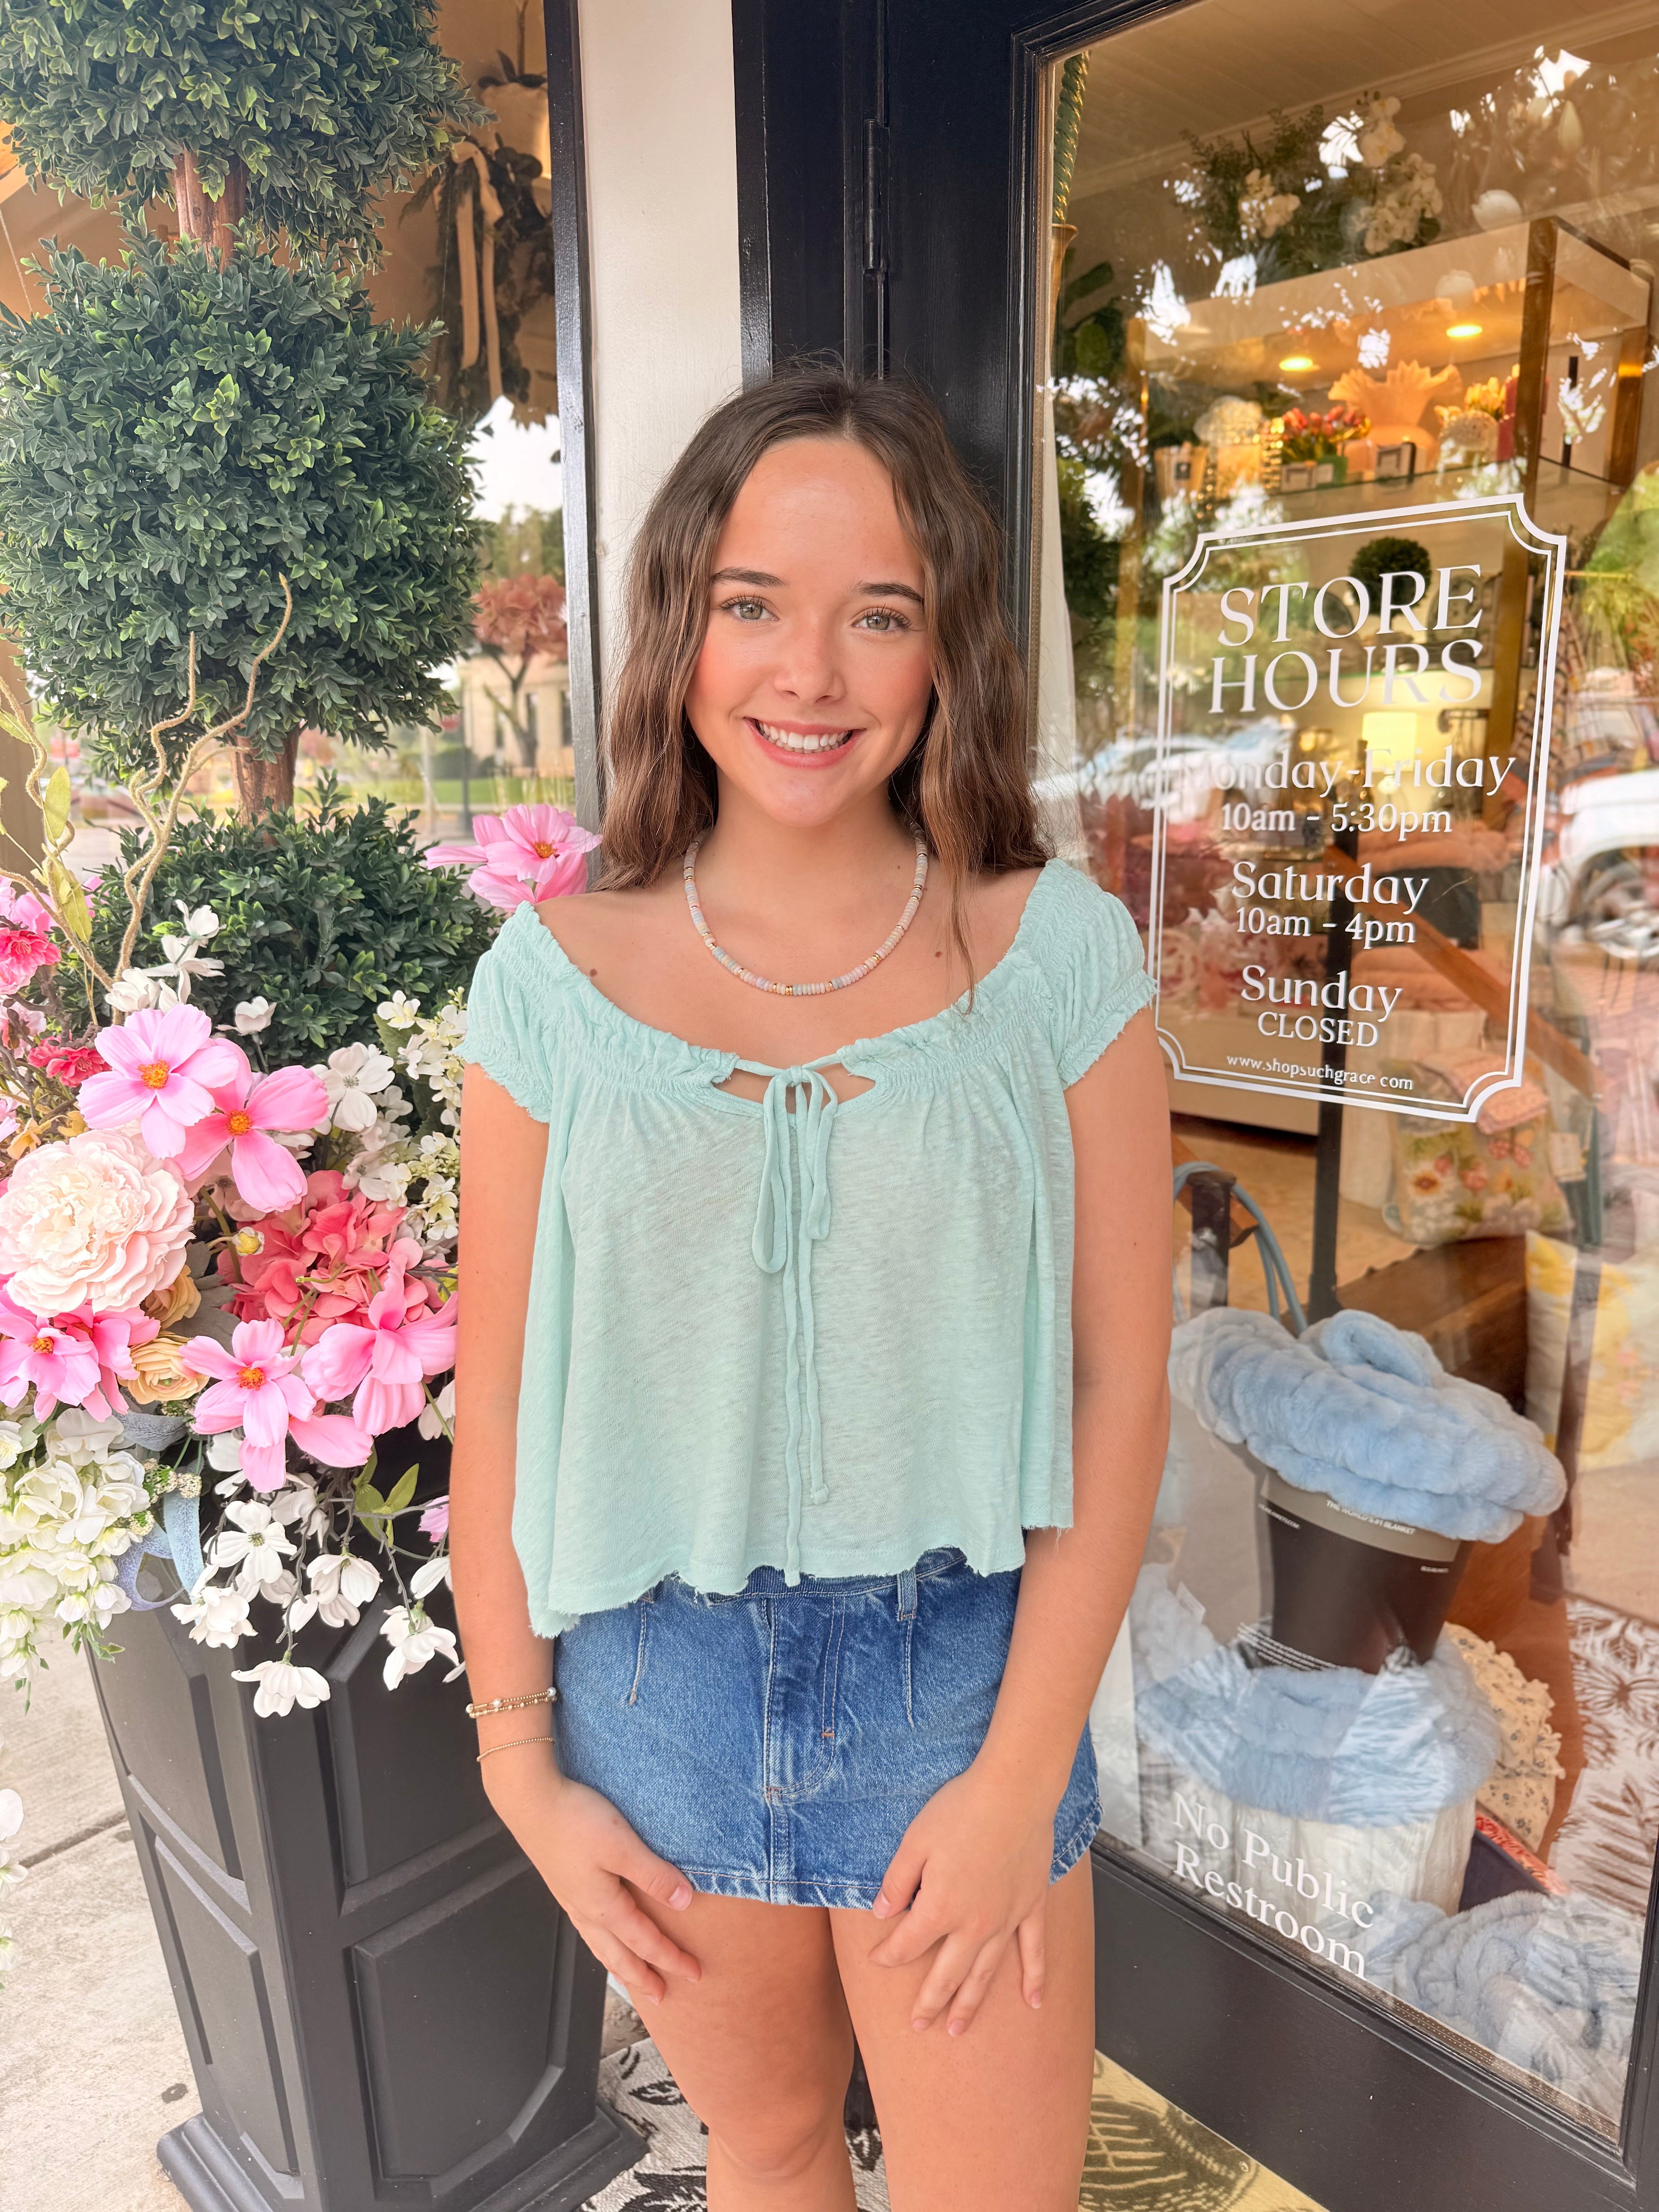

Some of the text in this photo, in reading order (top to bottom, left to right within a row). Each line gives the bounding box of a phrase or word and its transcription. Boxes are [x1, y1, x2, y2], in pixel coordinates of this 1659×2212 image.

[1218, 565, 1483, 646] STORE
[1208, 639, 1483, 714] HOURS
[1222, 802, 1295, 831] 10am
[1331, 802, 1452, 842] 5:30pm
[1231, 861, 1430, 915] Saturday
[1237, 907, 1311, 937] 10am
[1345, 912, 1416, 950] 4pm
[1241, 965, 1403, 1022] Sunday
[1258, 1012, 1378, 1047] CLOSED
[1227, 1056, 1413, 1090] www.shopsuchgracecom
[1326, 1499, 1342, 1512] THE
[1383, 1520, 1416, 1535] BLANKET
[1172, 1791, 1374, 1929] No Public
[1174, 1841, 1367, 1981] Restroom
